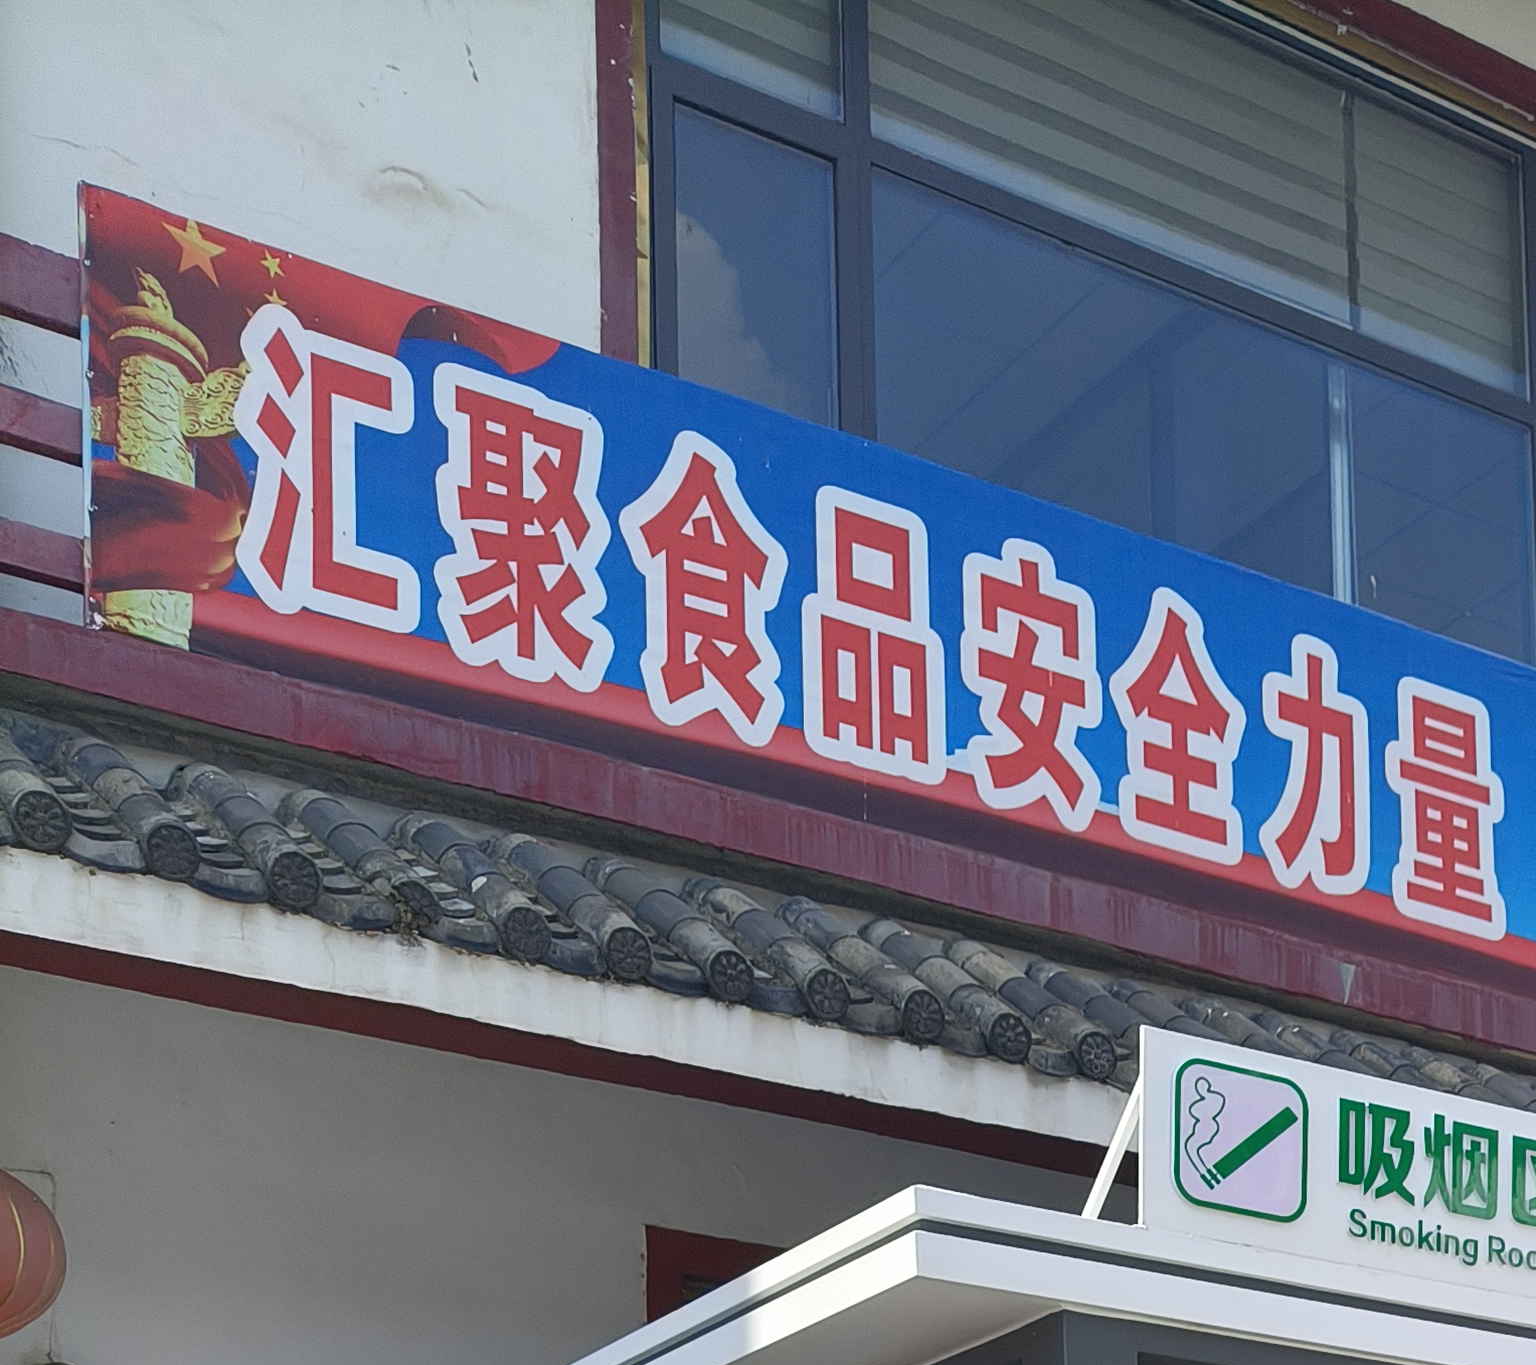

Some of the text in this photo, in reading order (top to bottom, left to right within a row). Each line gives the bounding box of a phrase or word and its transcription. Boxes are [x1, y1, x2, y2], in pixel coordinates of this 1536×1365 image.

[238, 306, 1505, 940] 汇聚食品安全力量
[1348, 1208, 1479, 1267] Smoking
